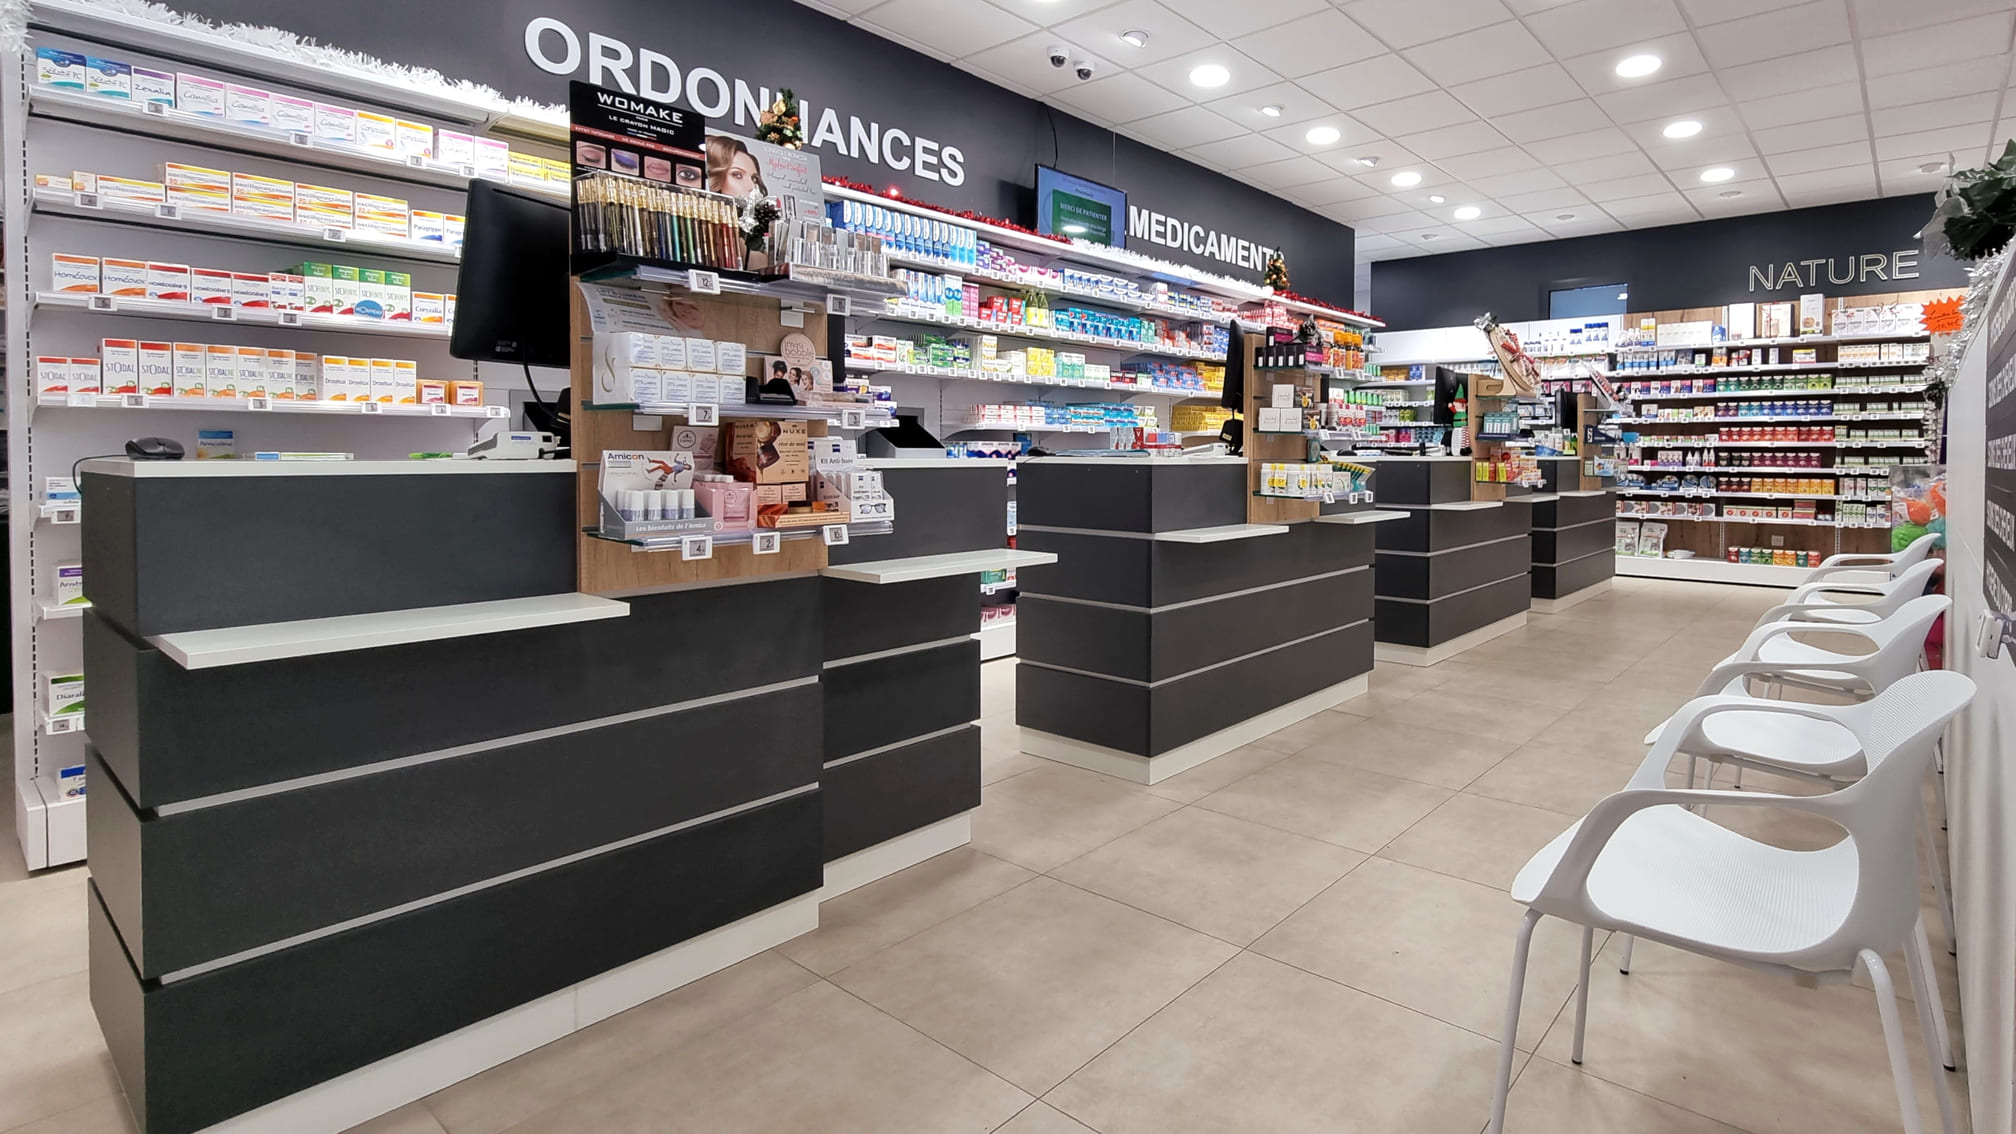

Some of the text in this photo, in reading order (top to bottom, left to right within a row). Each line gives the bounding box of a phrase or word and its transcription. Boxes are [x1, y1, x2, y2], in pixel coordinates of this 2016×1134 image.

[597, 91, 684, 124] WOMAKE
[1749, 249, 1920, 292] NATURE
[105, 361, 136, 374] STODAL
[141, 363, 171, 376] STODAL
